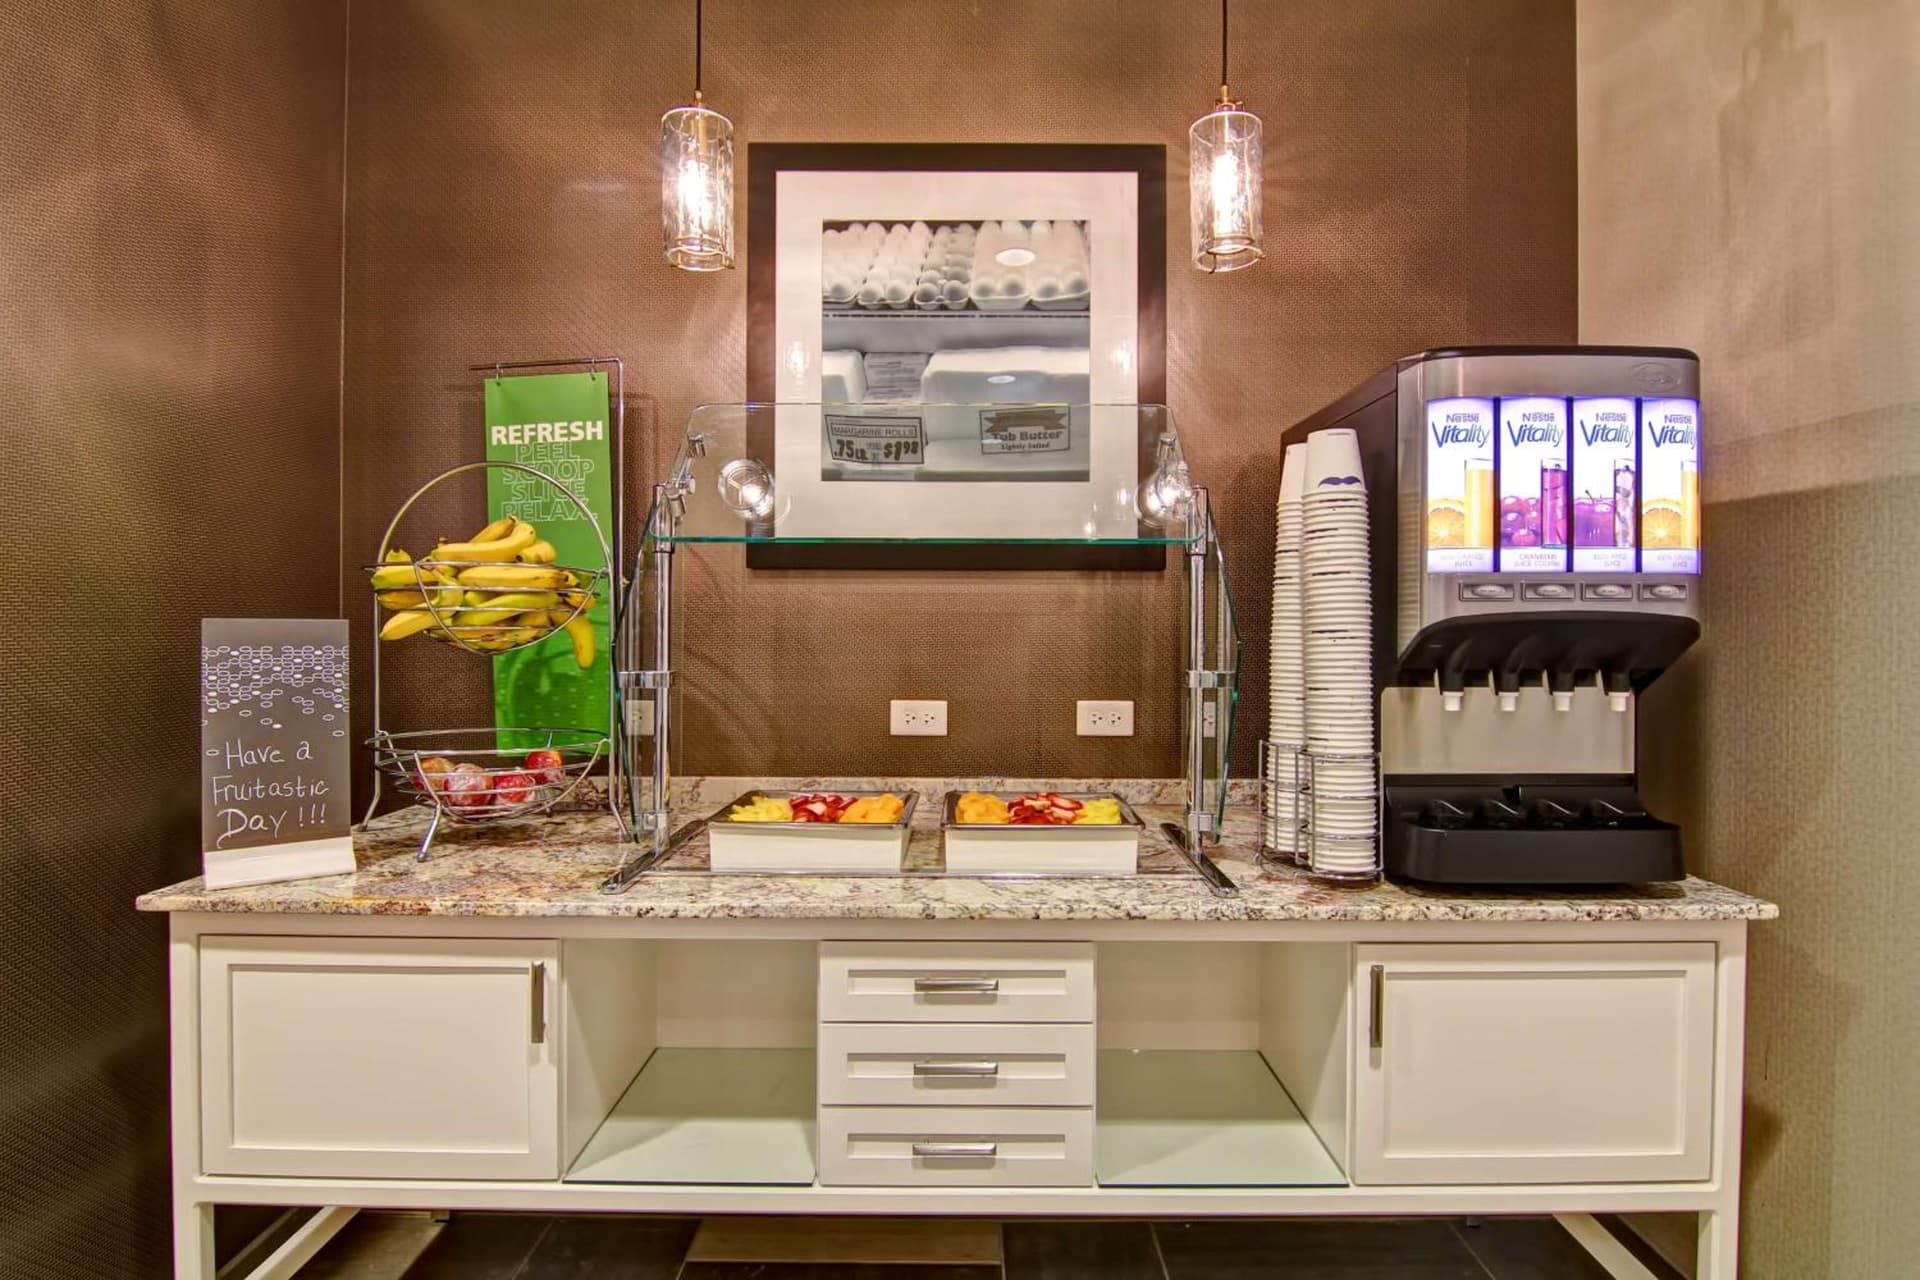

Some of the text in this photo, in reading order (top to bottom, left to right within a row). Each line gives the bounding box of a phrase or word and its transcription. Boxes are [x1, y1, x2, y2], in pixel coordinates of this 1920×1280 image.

[491, 421, 603, 446] REFRESH
[1019, 430, 1063, 441] Butter
[1431, 421, 1491, 448] Vitality
[1507, 420, 1564, 447] Vitality
[1580, 420, 1633, 448] Vitality
[1648, 421, 1696, 450] Vitality
[516, 440, 580, 463] PEEL
[502, 459, 595, 484] SCOOP
[512, 479, 586, 502] SLICE
[226, 738, 313, 770] Have a
[211, 775, 329, 806] Fruitastic
[216, 808, 288, 850] Day
